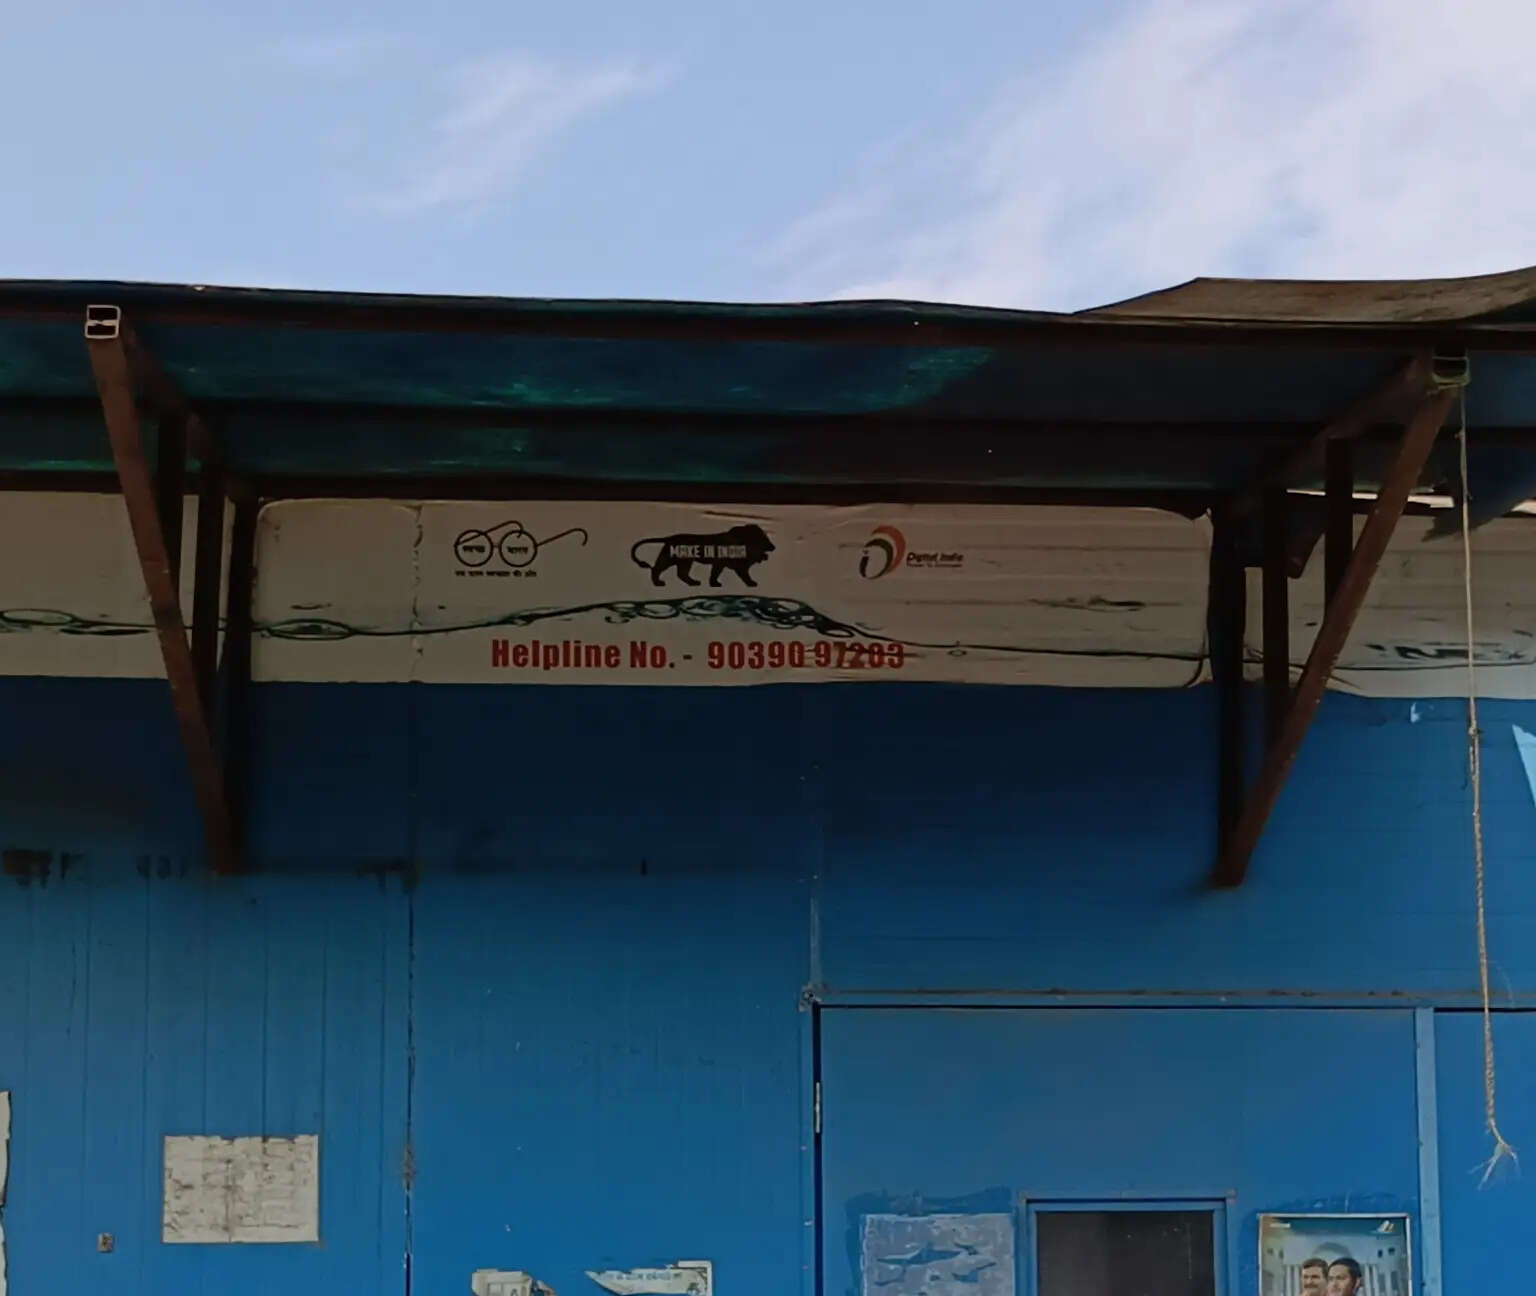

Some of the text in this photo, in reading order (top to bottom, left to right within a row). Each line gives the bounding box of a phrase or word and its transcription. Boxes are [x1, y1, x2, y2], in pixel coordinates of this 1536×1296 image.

[669, 545, 747, 560] MAKE IN INDIA
[491, 640, 620, 671] Helpline
[630, 640, 675, 669] No.
[707, 640, 801, 670] 90390
